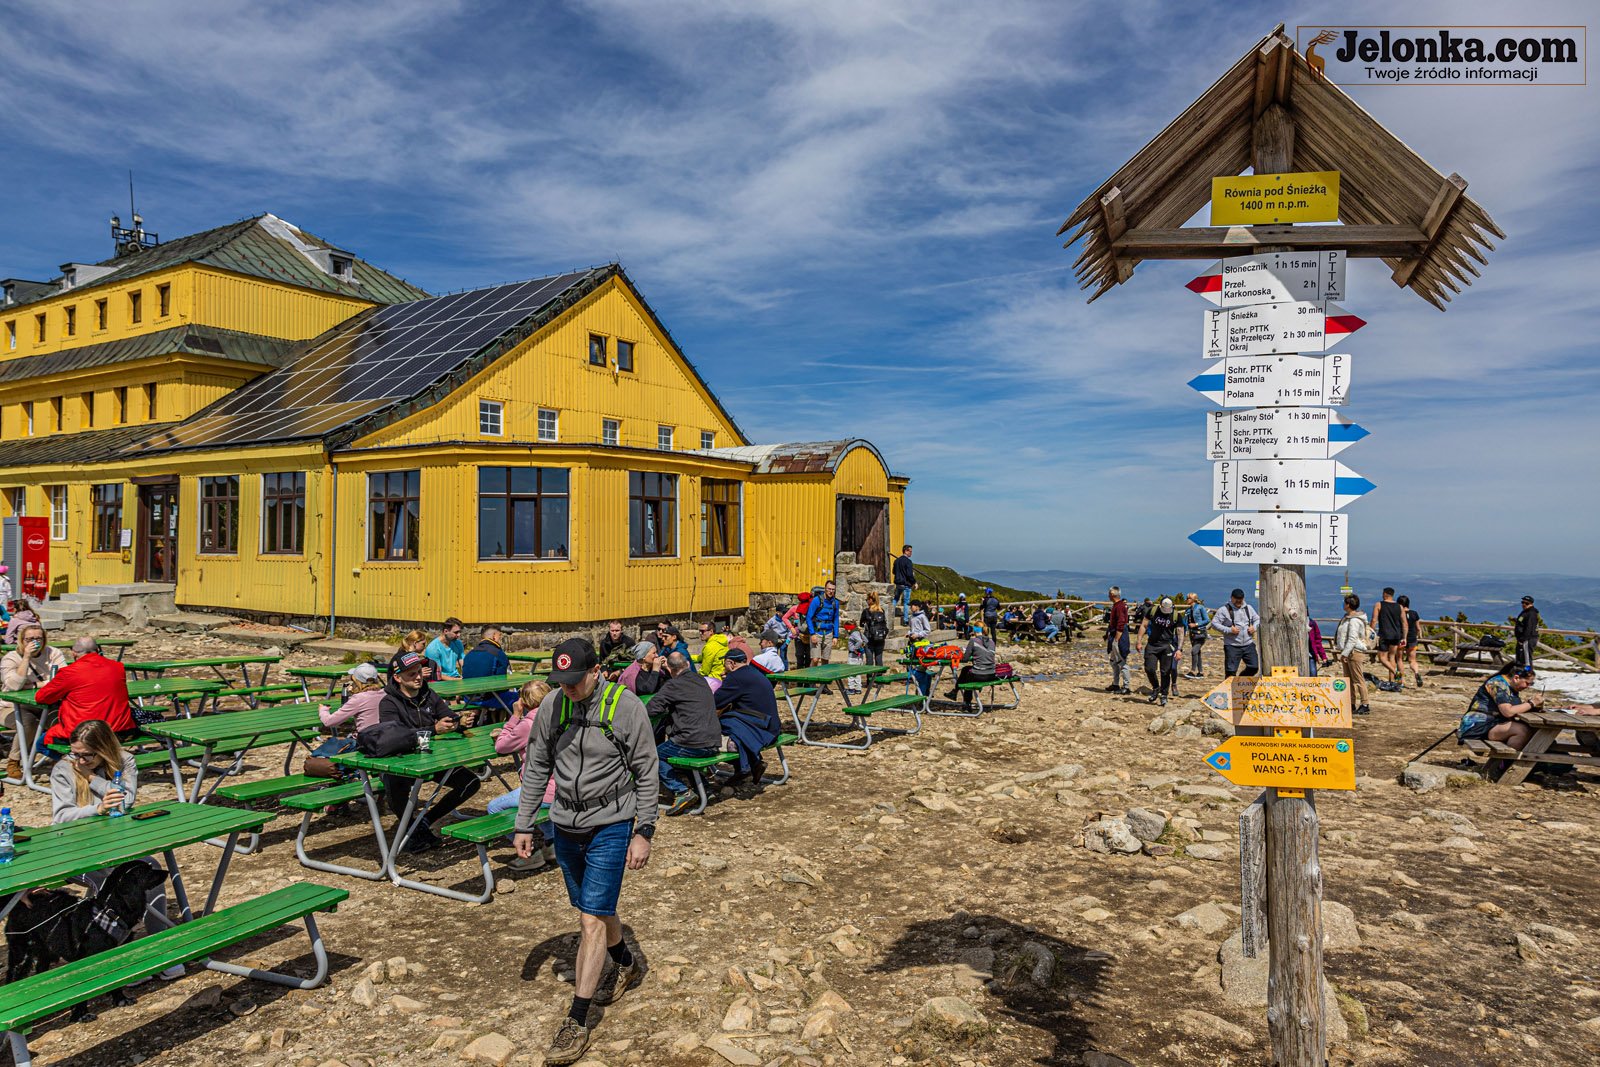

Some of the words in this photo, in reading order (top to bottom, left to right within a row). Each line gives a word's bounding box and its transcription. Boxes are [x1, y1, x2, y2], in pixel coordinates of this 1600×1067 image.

[1224, 187, 1261, 198] Równia
[1264, 186, 1284, 198] pod
[1286, 183, 1327, 196] Śnieżką
[1240, 201, 1263, 210] 1400
[1265, 201, 1275, 209] m
[1278, 200, 1309, 209] n.p.m.
[1224, 262, 1268, 274] Słonecznik
[1301, 260, 1317, 268] min
[1327, 252, 1337, 291] PTTK
[1224, 280, 1246, 290] Przeł.
[1310, 280, 1316, 288] h
[1224, 288, 1272, 299] Karkonoska
[1230, 311, 1258, 320] Śnieżka
[1211, 310, 1220, 348] PTTK
[1230, 327, 1248, 335] Schr.
[1249, 324, 1269, 332] PTTK
[1289, 331, 1295, 339] h
[1307, 330, 1322, 338] min
[1230, 335, 1240, 343] Na
[1241, 333, 1275, 342] Przełęczy
[1230, 344, 1249, 352] Okraj
[1227, 366, 1248, 374] Schr.
[1250, 364, 1273, 373] PTTK
[1227, 375, 1265, 384] Samotnia
[1332, 356, 1342, 395] PTTK
[1227, 390, 1254, 398] Polana
[1234, 414, 1257, 423] Skalny
[1259, 413, 1274, 421] Stół
[1214, 411, 1223, 450] PTTK
[1233, 437, 1243, 445] Na
[1244, 436, 1278, 445] Przełęczy
[1233, 445, 1252, 454] Okraj
[1221, 462, 1230, 501] PTTK
[1242, 474, 1268, 482] Sowia
[1285, 480, 1298, 488] 1h
[1298, 480, 1310, 488] 15
[1312, 480, 1330, 489] min
[1242, 486, 1279, 495] Przełęcz
[1226, 519, 1252, 527] Karpacz
[1226, 527, 1245, 536] Górny
[1246, 527, 1265, 536] Wang
[1329, 515, 1339, 556] PTTK
[1226, 541, 1251, 549] Karpacz
[1252, 541, 1277, 550] (rondo)
[1226, 549, 1241, 558] Biały
[1242, 691, 1273, 701] KOPA
[1300, 692, 1317, 702] km
[1242, 704, 1295, 714] KARPACZ
[1305, 705, 1320, 716] 4,9
[1323, 705, 1340, 714] km
[1251, 752, 1295, 762] POLANA
[1304, 754, 1309, 763] 5
[1312, 754, 1328, 763] km
[1253, 764, 1285, 774] WANG
[1294, 766, 1309, 775] 7,1
[1312, 766, 1327, 776] km
